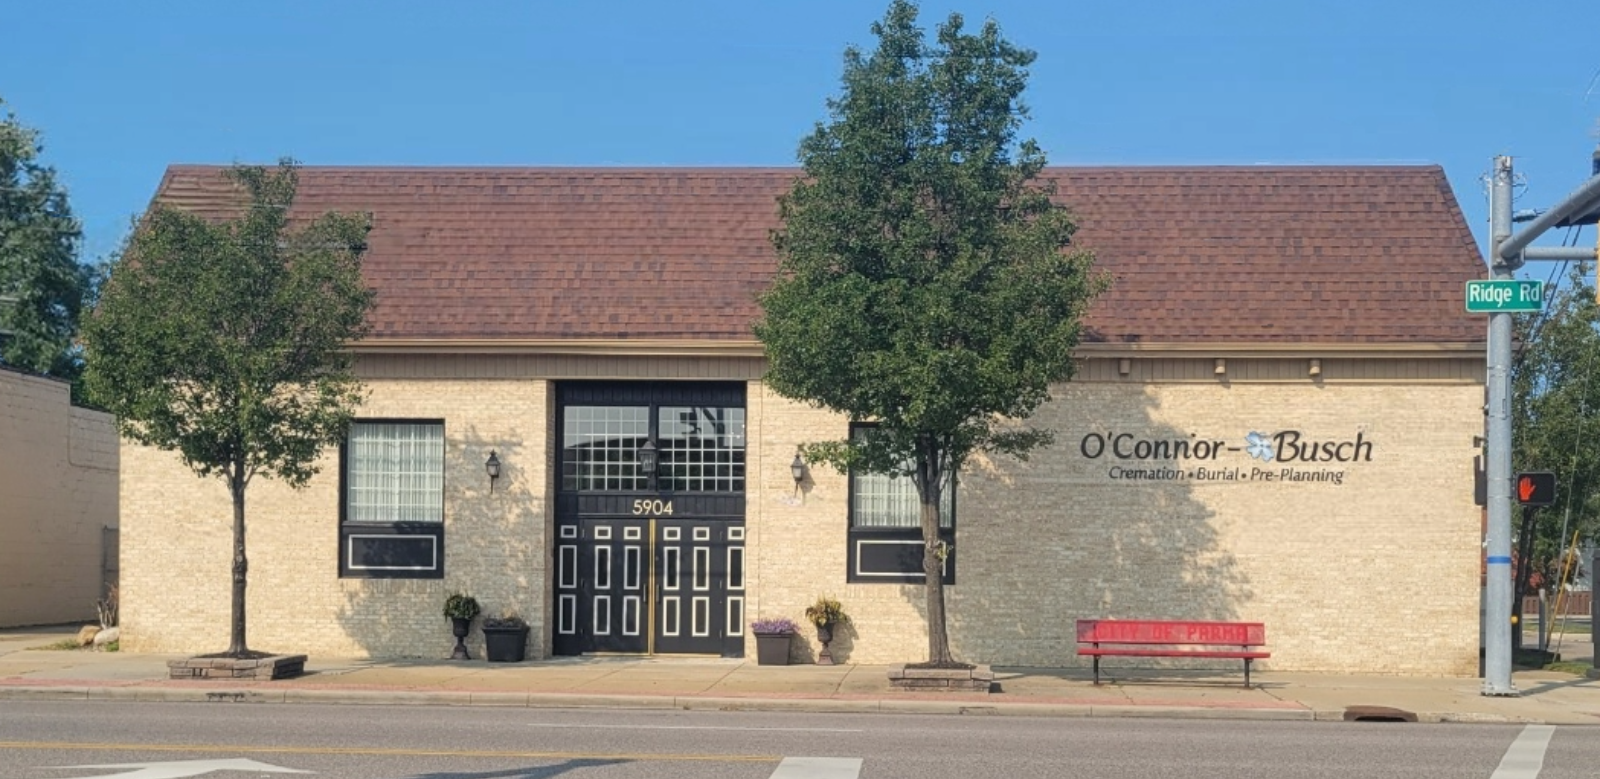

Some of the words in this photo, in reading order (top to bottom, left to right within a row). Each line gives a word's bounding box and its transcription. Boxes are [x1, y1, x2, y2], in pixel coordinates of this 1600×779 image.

[1469, 283, 1513, 308] Ridge
[1520, 283, 1540, 302] Rd
[1273, 430, 1373, 462] Busch
[1108, 466, 1185, 481] Cremation
[1196, 467, 1239, 481] Burial
[1250, 468, 1344, 484] Pre-Planning
[632, 499, 674, 516] 5904
[1094, 623, 1139, 639] CITY
[1152, 624, 1172, 640] OF
[1187, 624, 1247, 641] PARMA
